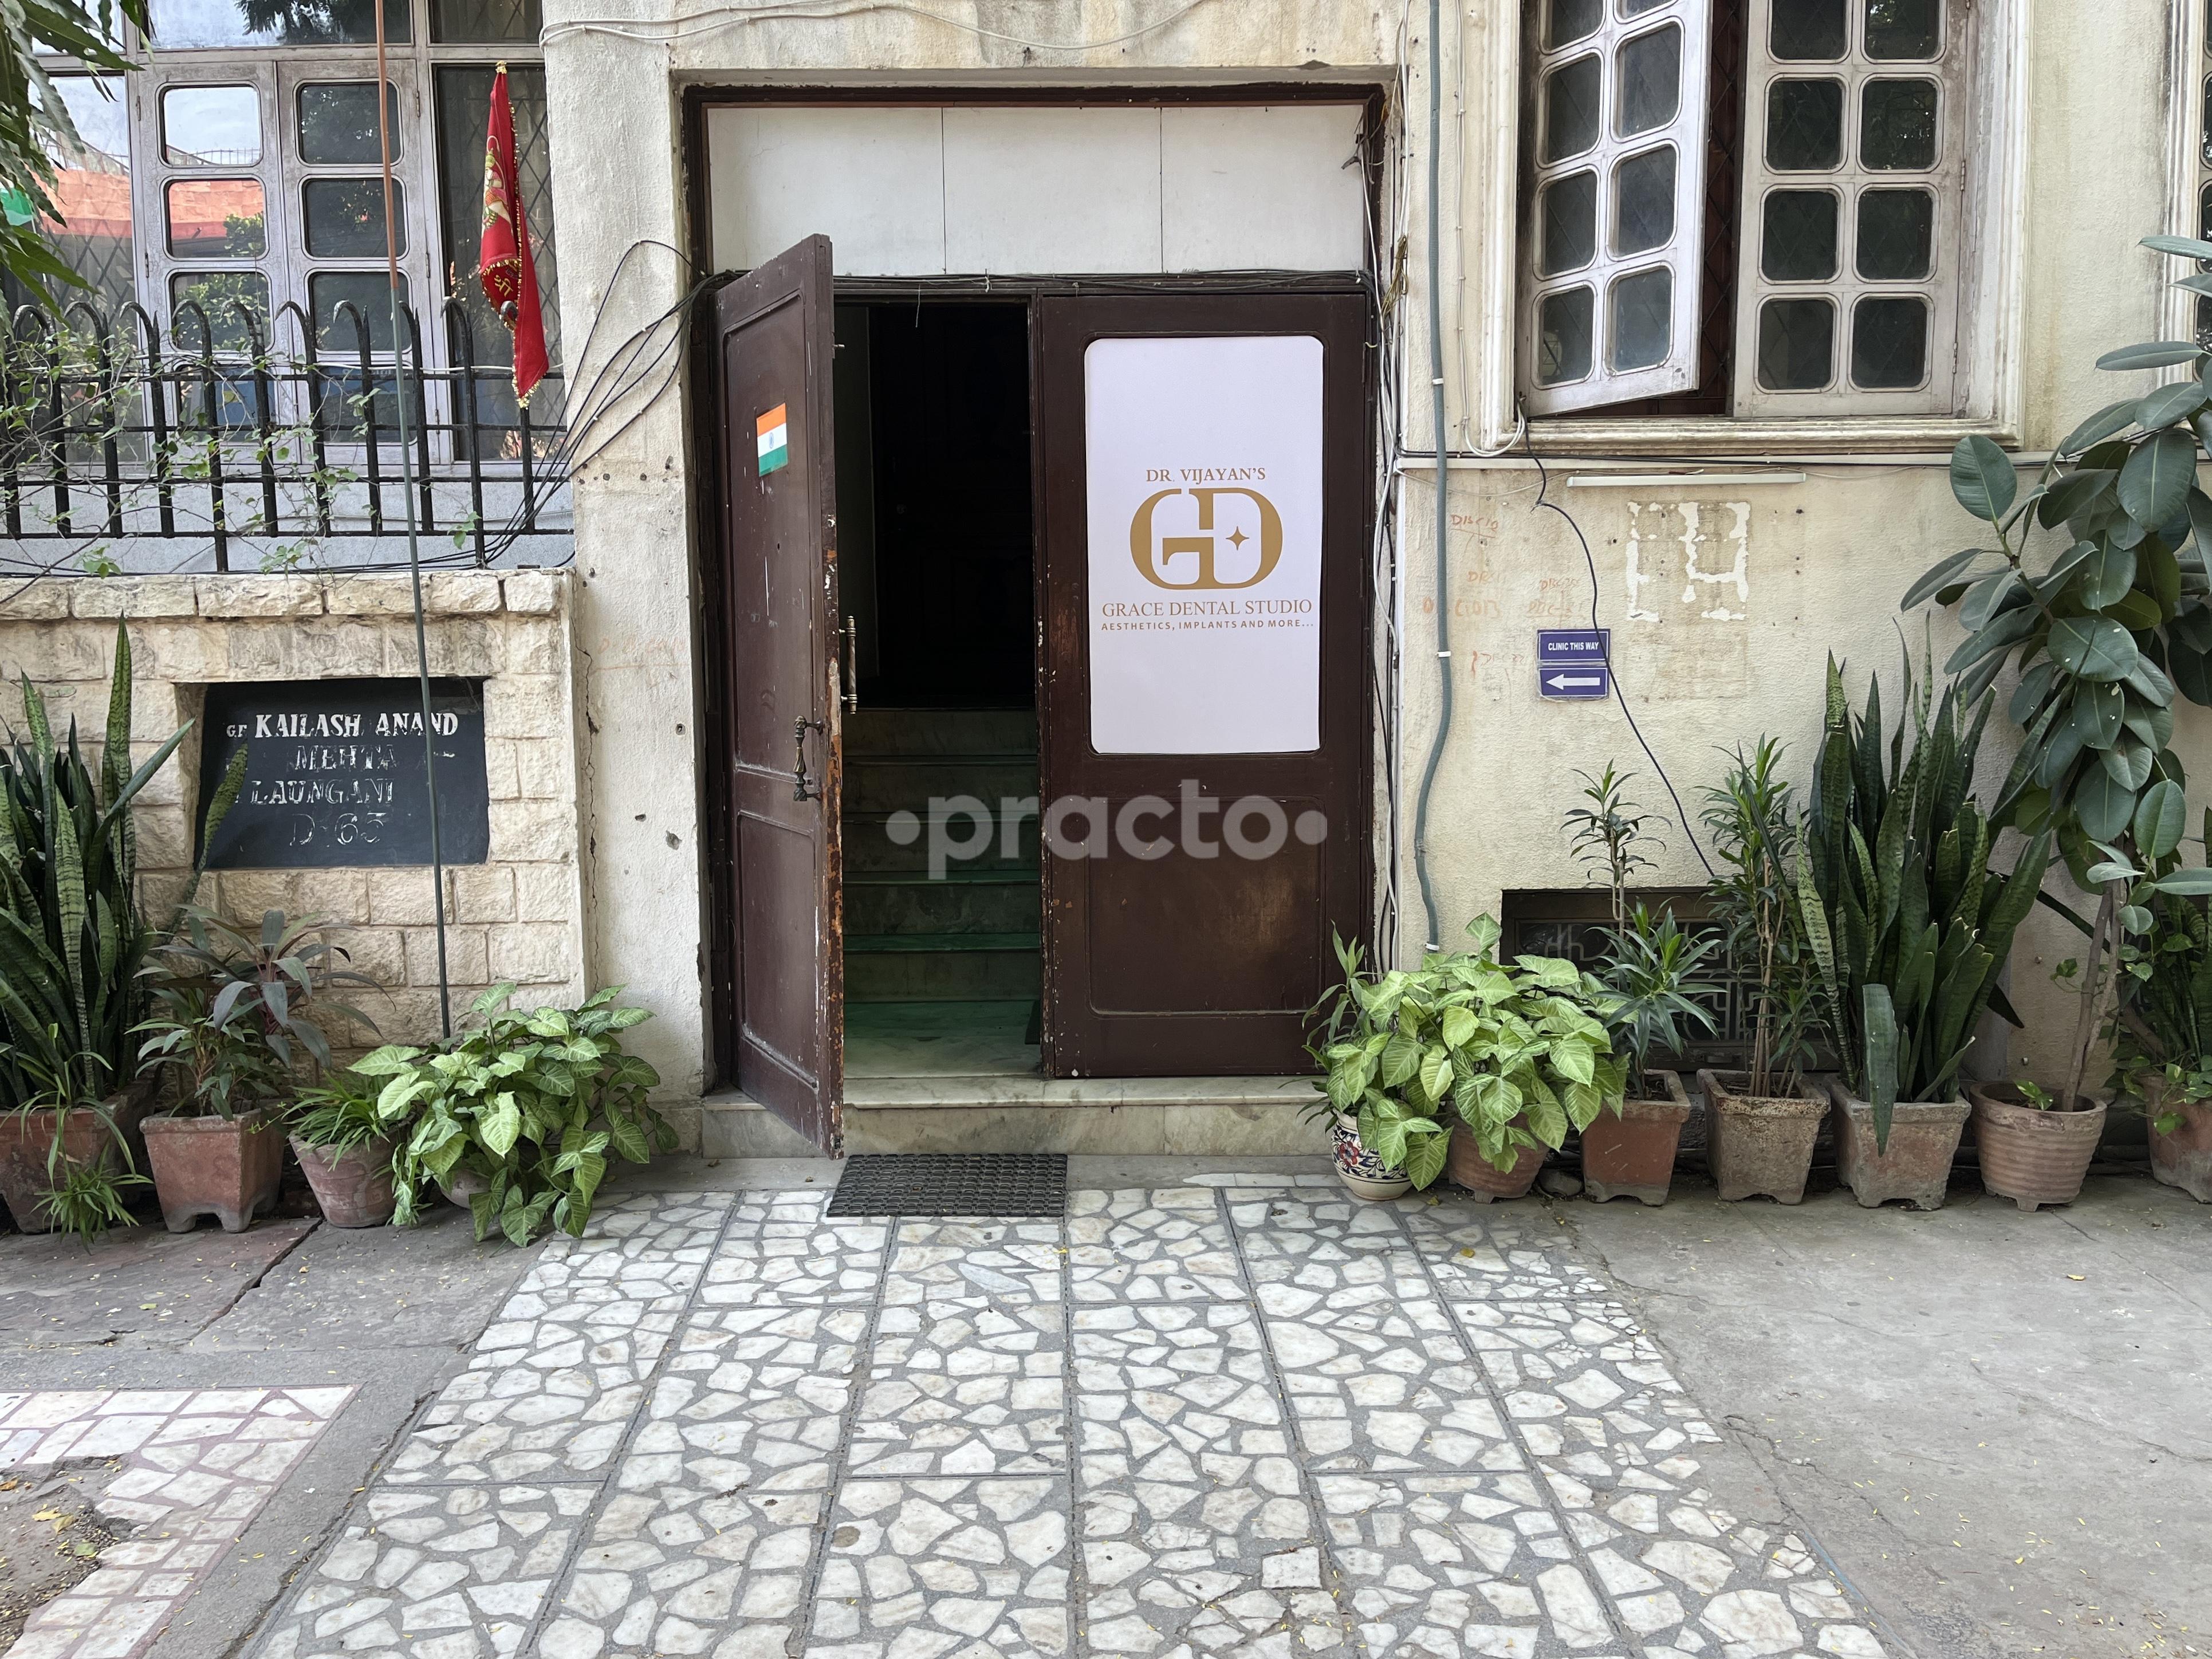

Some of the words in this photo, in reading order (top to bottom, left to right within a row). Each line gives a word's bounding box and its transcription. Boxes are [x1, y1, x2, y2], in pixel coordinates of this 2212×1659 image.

[1180, 467, 1266, 485] VIJAYAN'S
[1102, 602, 1164, 617] GRACE
[1169, 601, 1240, 616] DENTAL
[1245, 599, 1312, 615] STUDIO
[1101, 622, 1175, 631] AESTHETICS,
[1179, 620, 1237, 629] IMPLANTS
[1548, 642, 1569, 651] CLINIC
[1570, 642, 1584, 651] THIS
[1585, 642, 1599, 650] WAY
[254, 714, 361, 738] KAILASH
[375, 712, 459, 737] ANAND
